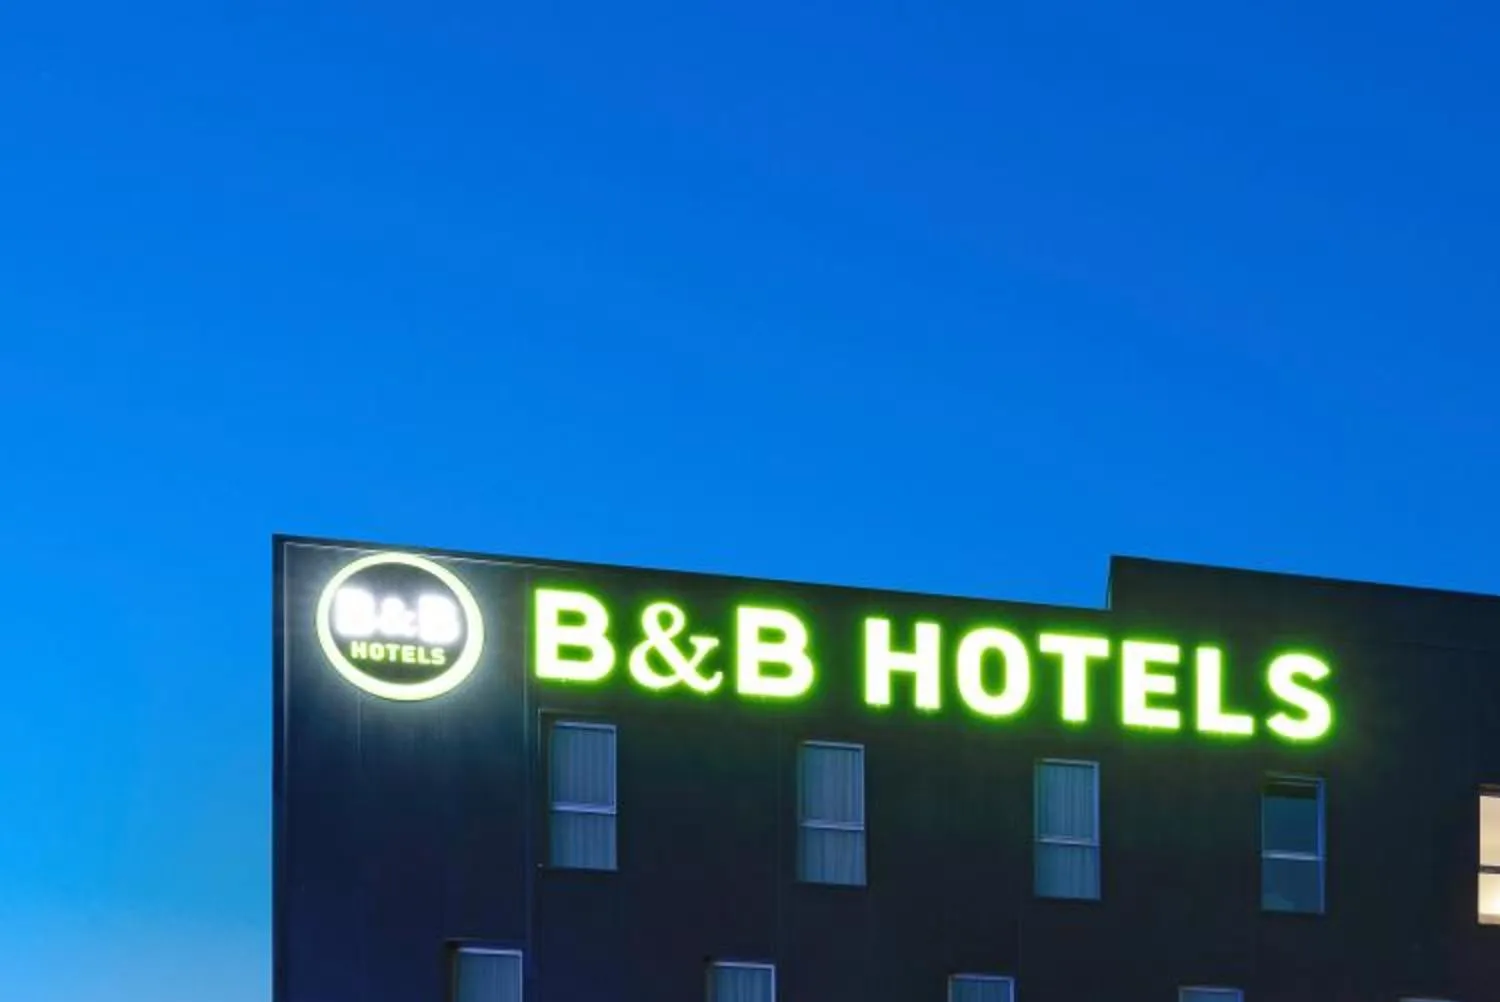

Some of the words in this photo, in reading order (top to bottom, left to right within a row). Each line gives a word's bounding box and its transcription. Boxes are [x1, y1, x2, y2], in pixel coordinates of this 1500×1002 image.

[350, 640, 447, 666] HOTELS
[534, 587, 815, 698] B&B
[863, 616, 1333, 741] HOTELS
